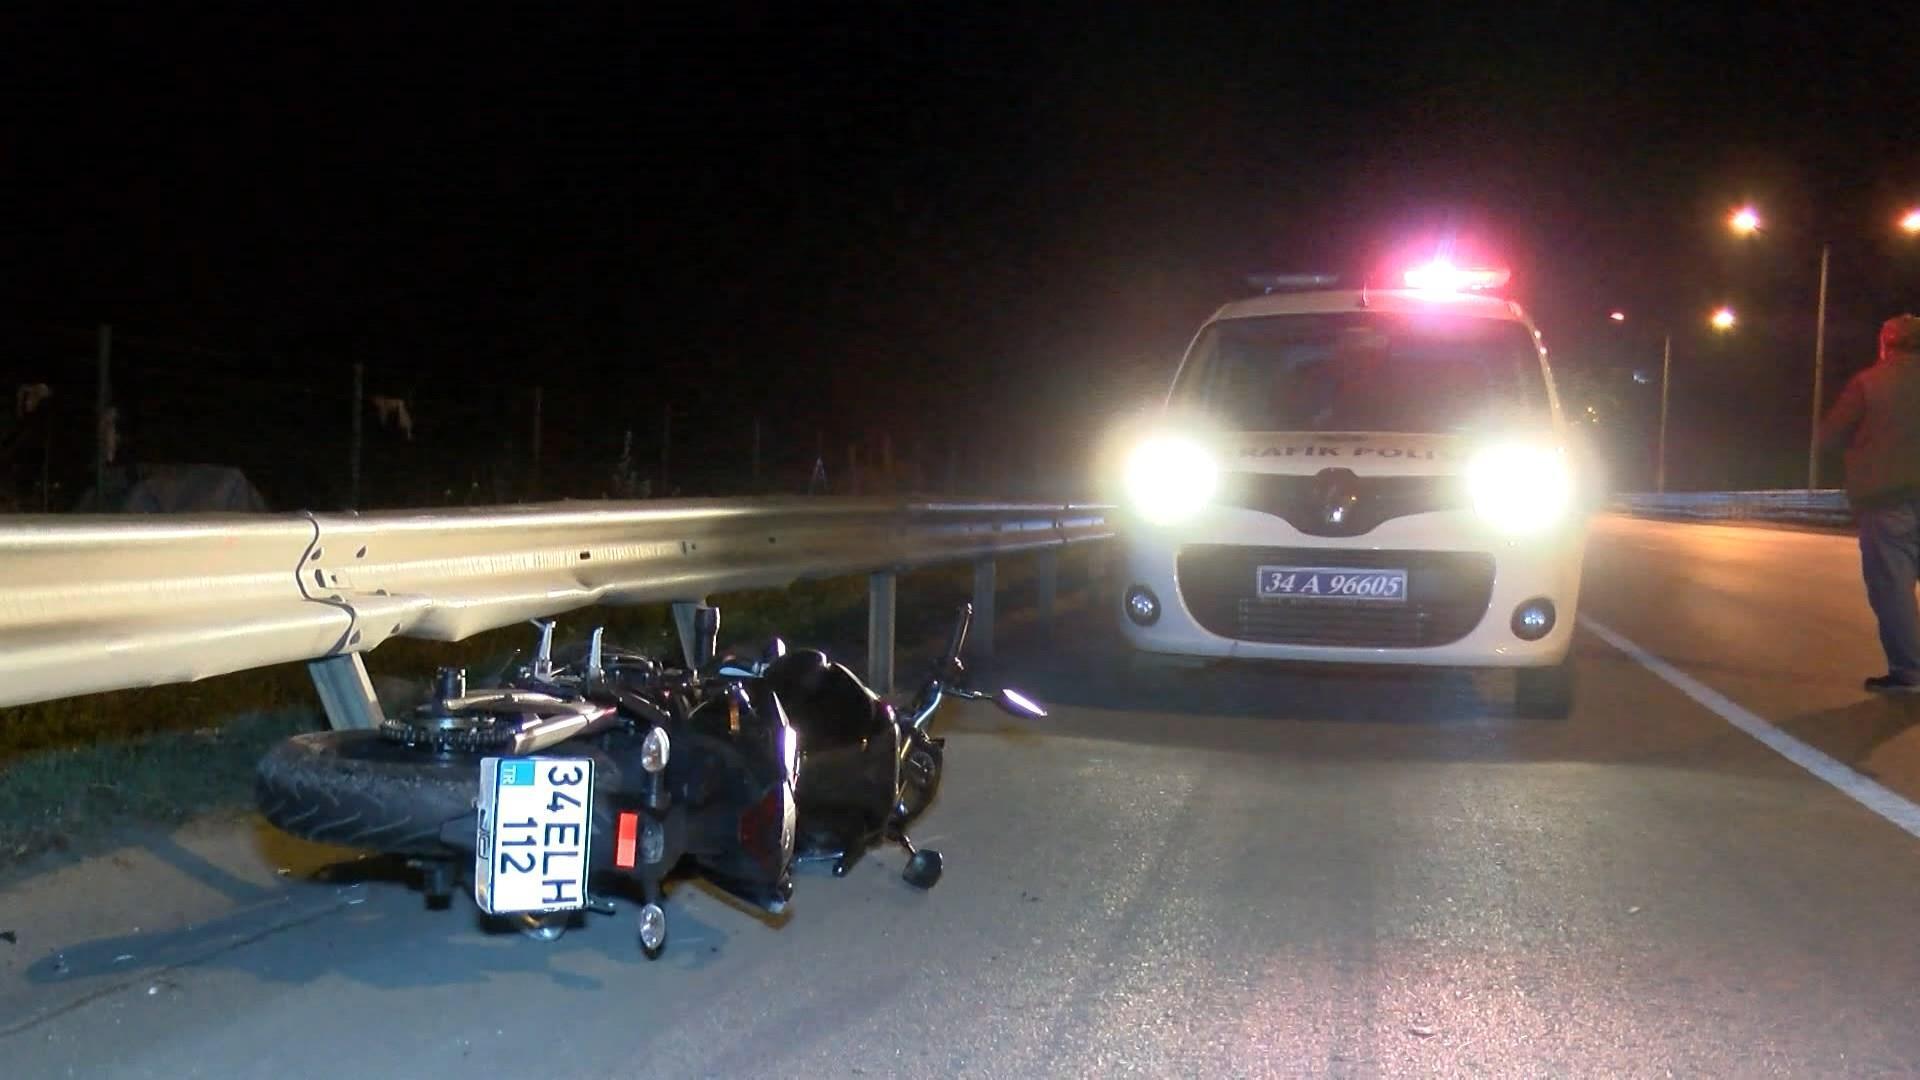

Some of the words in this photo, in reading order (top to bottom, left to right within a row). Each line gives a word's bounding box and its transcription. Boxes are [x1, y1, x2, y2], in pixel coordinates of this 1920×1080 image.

[1265, 572, 1297, 593] 34
[1300, 574, 1320, 594] A
[1328, 574, 1402, 597] 96605
[502, 765, 517, 785] TR
[500, 817, 538, 874] 112
